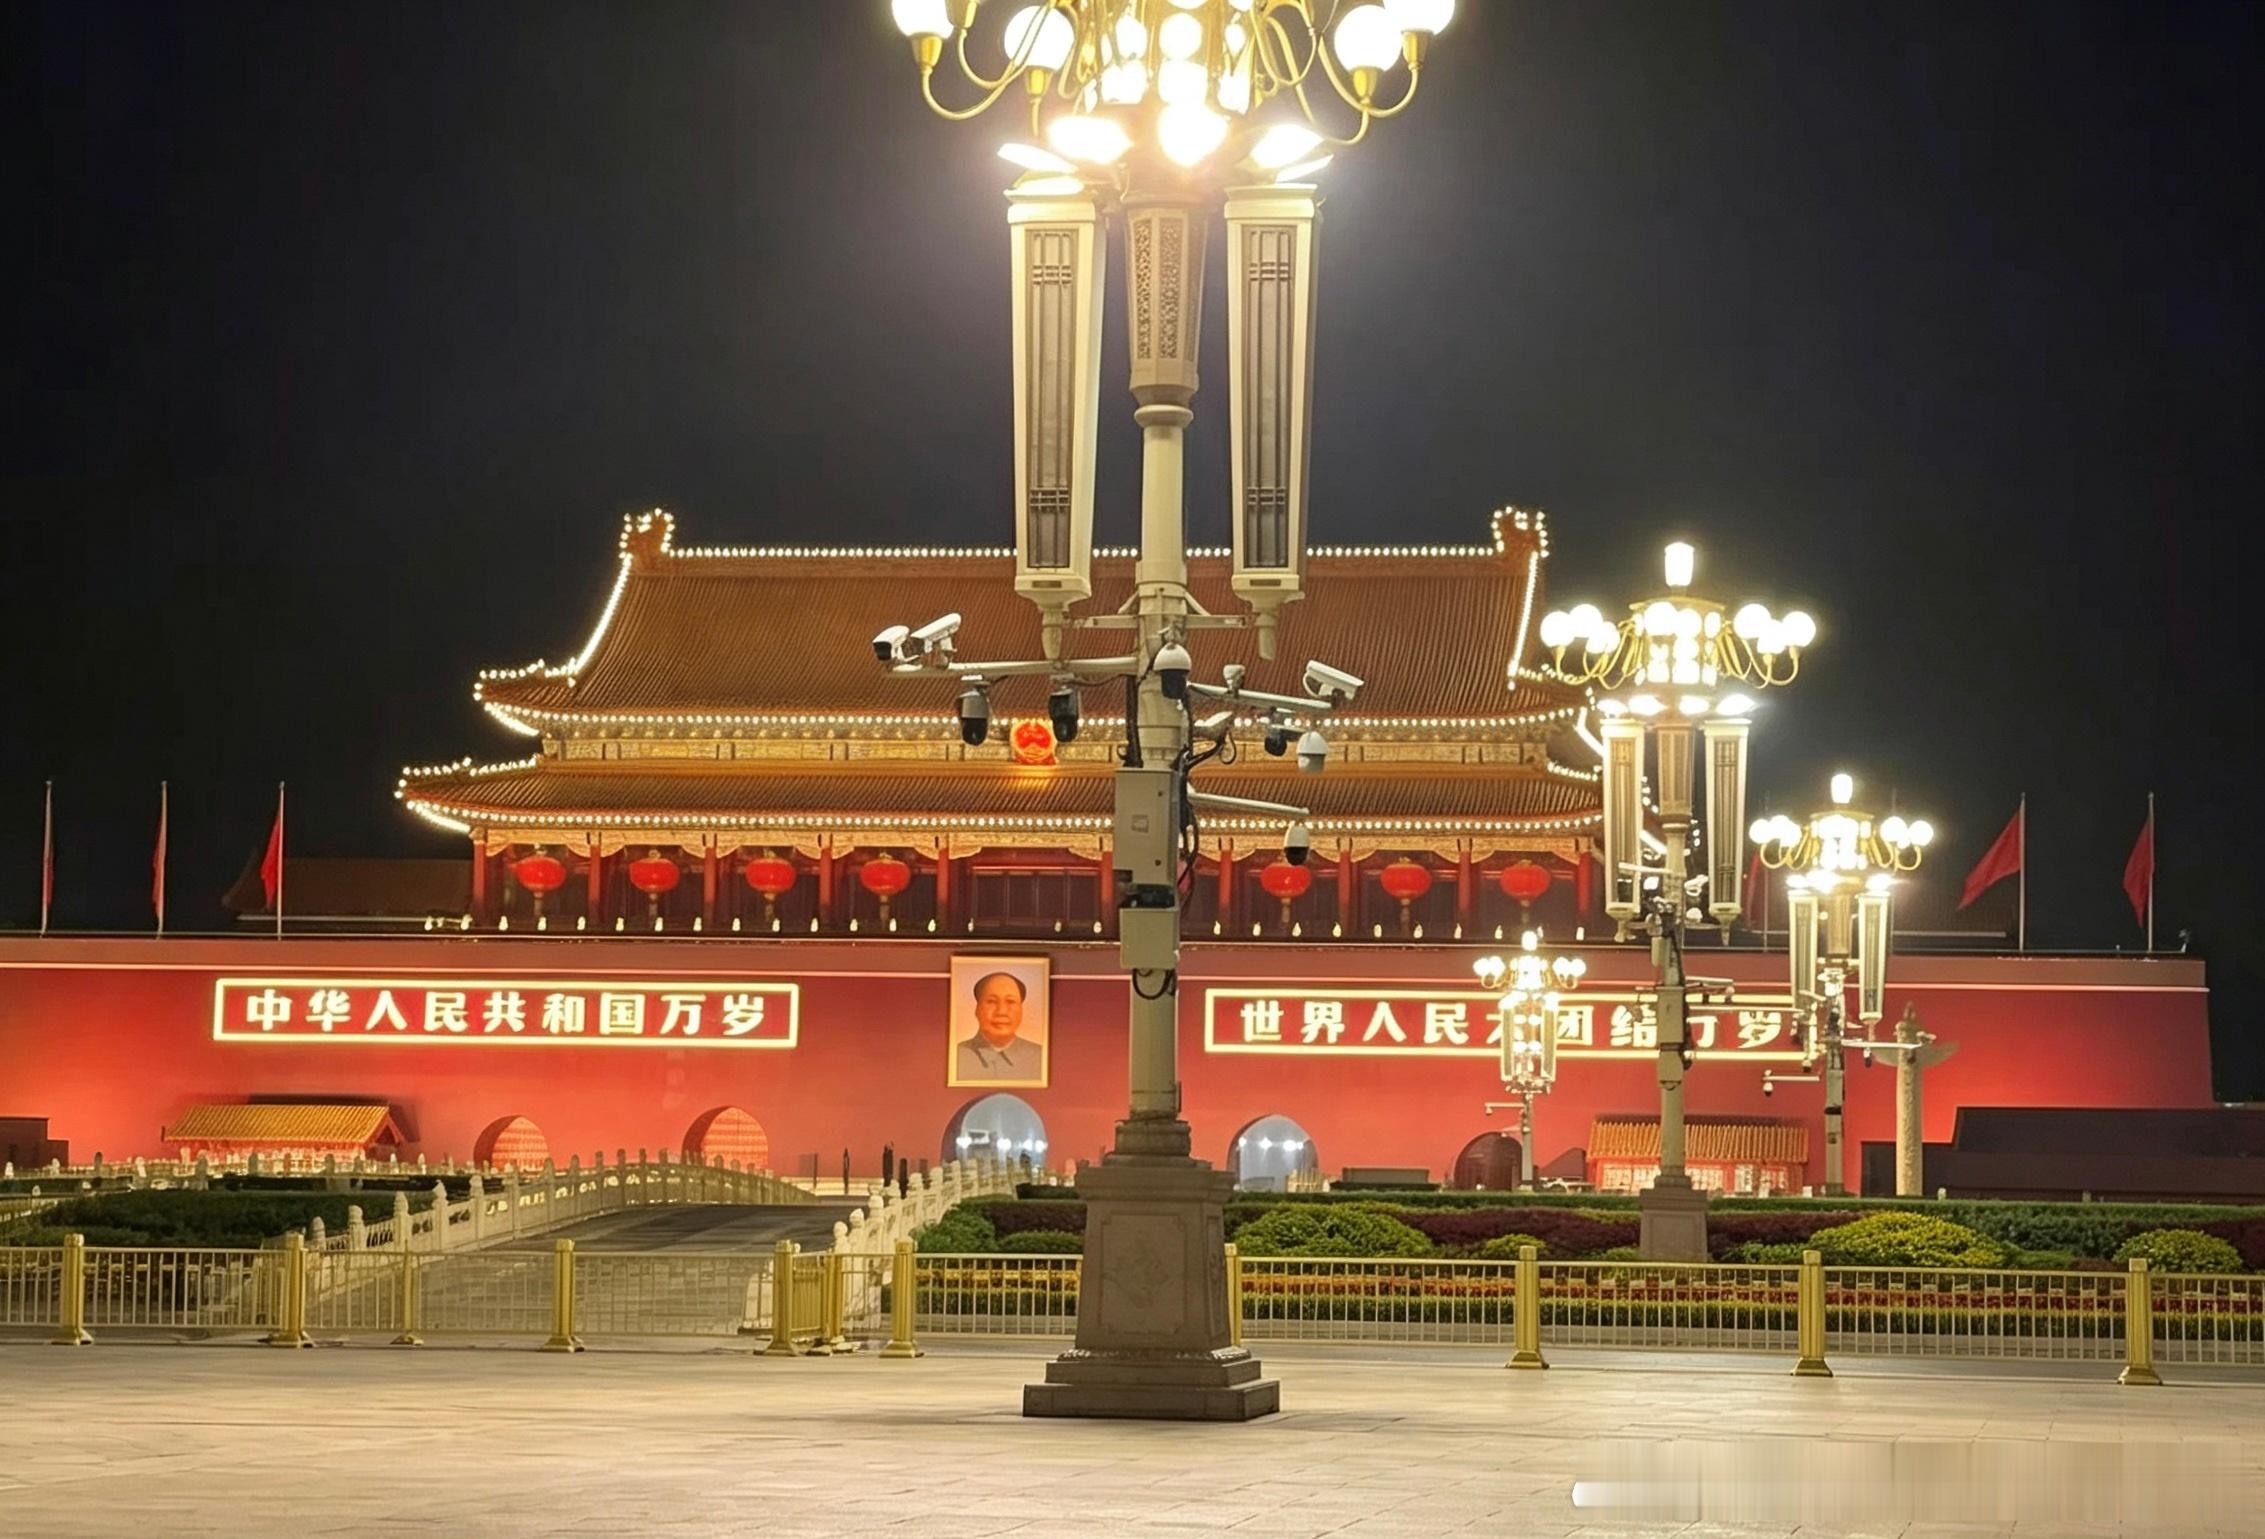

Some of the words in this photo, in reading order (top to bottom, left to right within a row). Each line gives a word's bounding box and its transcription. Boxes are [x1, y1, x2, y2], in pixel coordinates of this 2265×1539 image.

[247, 988, 765, 1035] 中华人民共和国万岁
